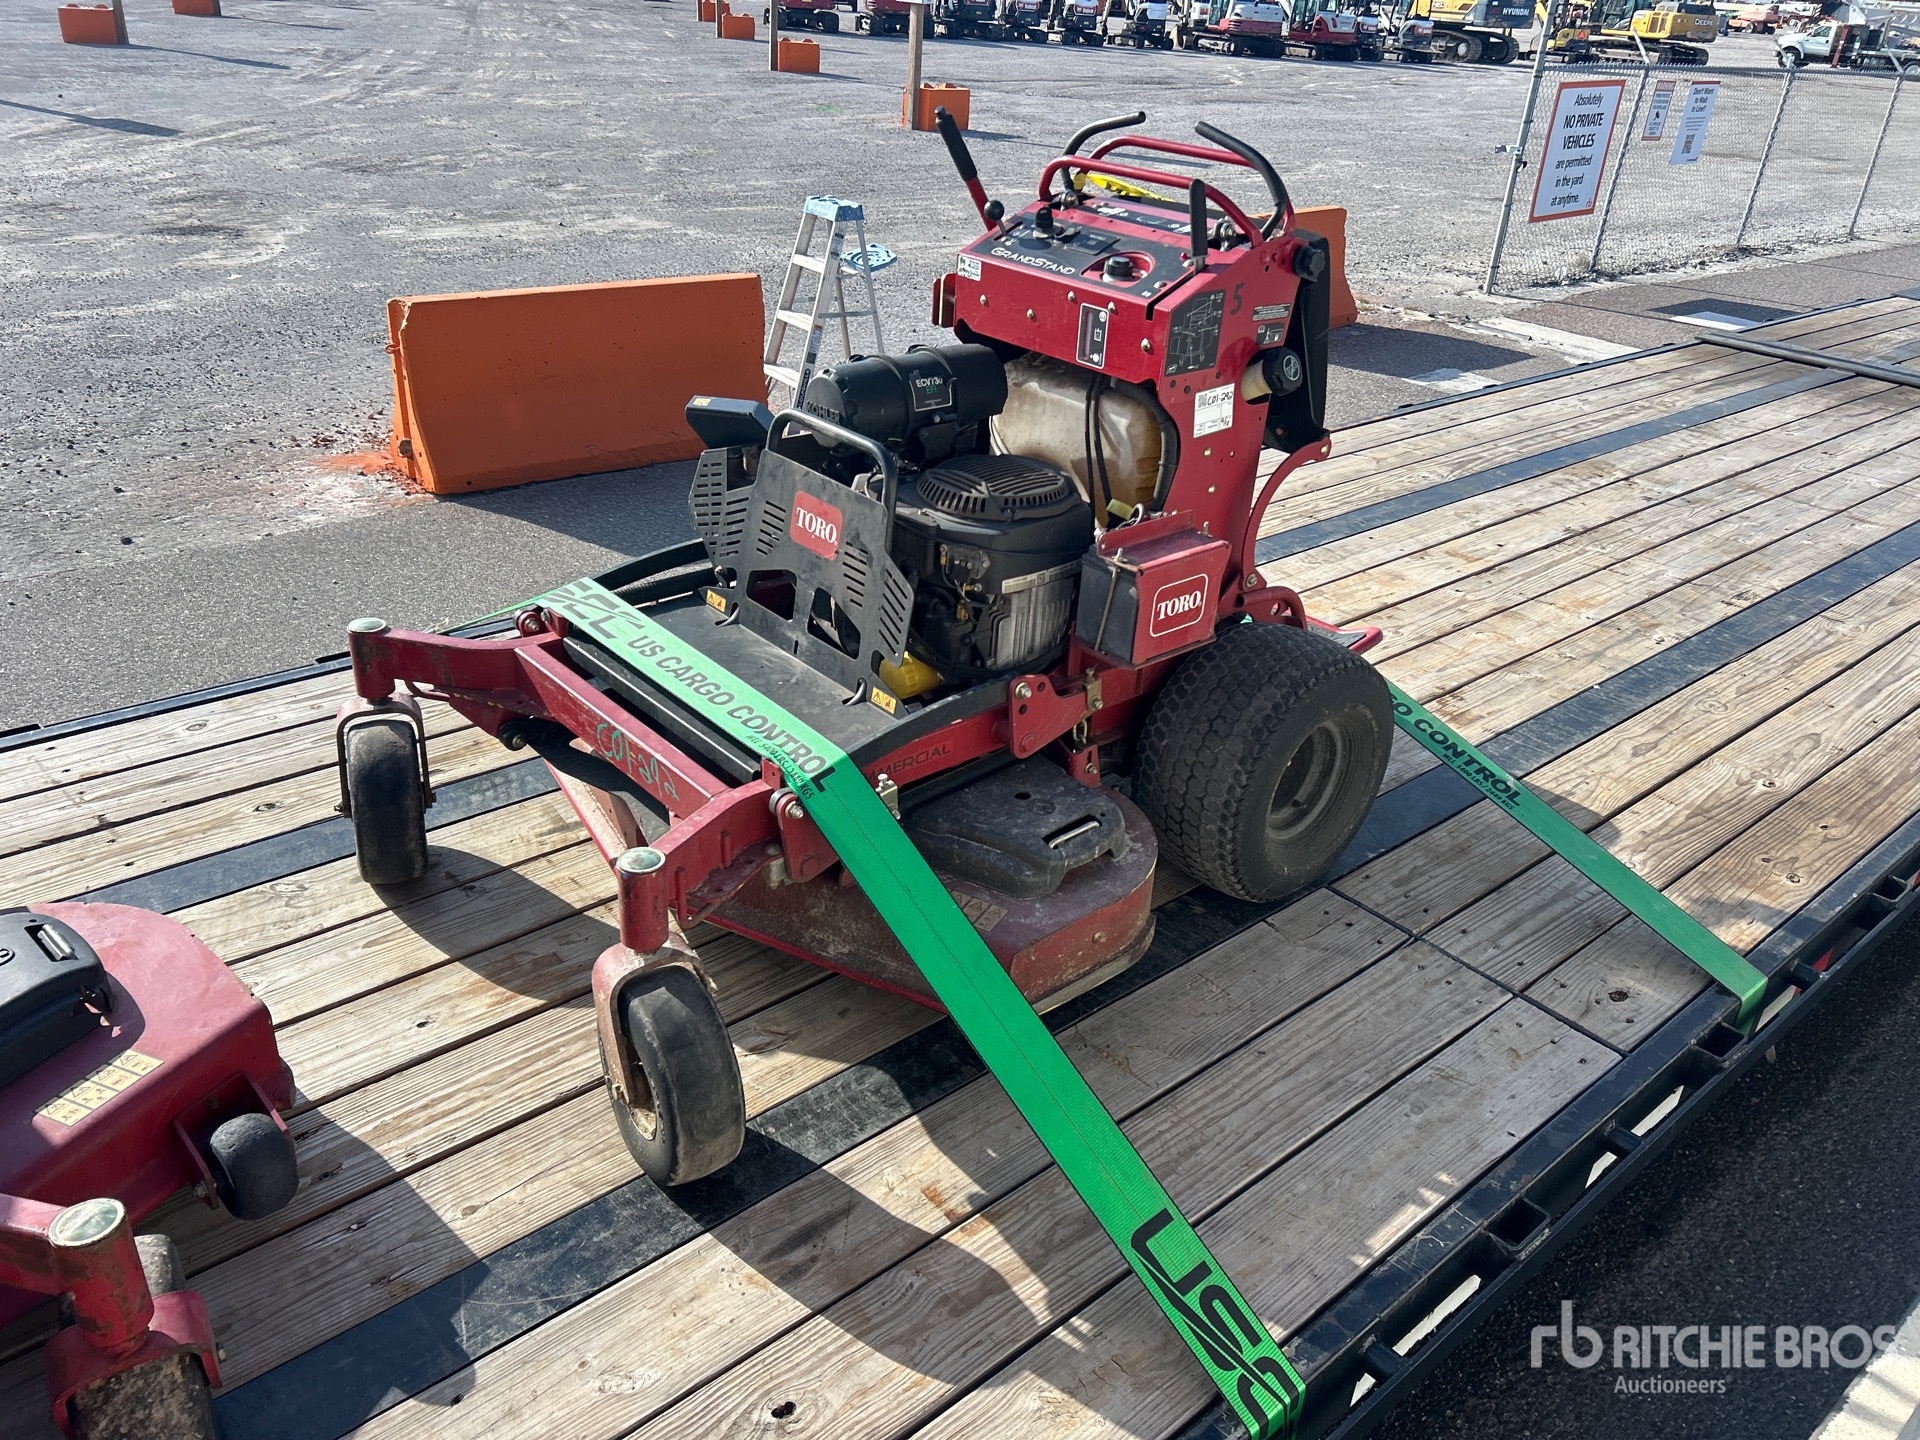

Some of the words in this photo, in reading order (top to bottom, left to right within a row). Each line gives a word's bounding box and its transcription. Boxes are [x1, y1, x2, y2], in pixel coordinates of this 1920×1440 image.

[1502, 7, 1530, 16] HYUNDAI
[1694, 18, 1714, 26] DEERE
[1574, 92, 1604, 108] Absolutely
[1563, 114, 1576, 129] NO
[1575, 113, 1604, 128] PRIVATE
[1563, 133, 1596, 149] VEHICLES
[1555, 160, 1566, 169] are
[1564, 154, 1593, 171] permitted
[1555, 175, 1562, 187] in
[1562, 174, 1571, 187] the
[1570, 172, 1585, 189] yard
[1550, 195, 1558, 207] at
[1557, 192, 1579, 208] anytime
[1230, 282, 1245, 315] 5
[806, 401, 841, 426] KOHLER
[796, 506, 838, 546] TORO
[1157, 590, 1202, 620] TORO
[627, 635, 666, 657] US
[655, 656, 735, 706] CARGO
[726, 705, 836, 793] CONTROL
[1413, 718, 1522, 807] CONTROL
[799, 783, 815, 800] KGS
[1456, 764, 1472, 777] 5400
[1470, 775, 1485, 786] LBS
[1501, 799, 1516, 810] KGS
